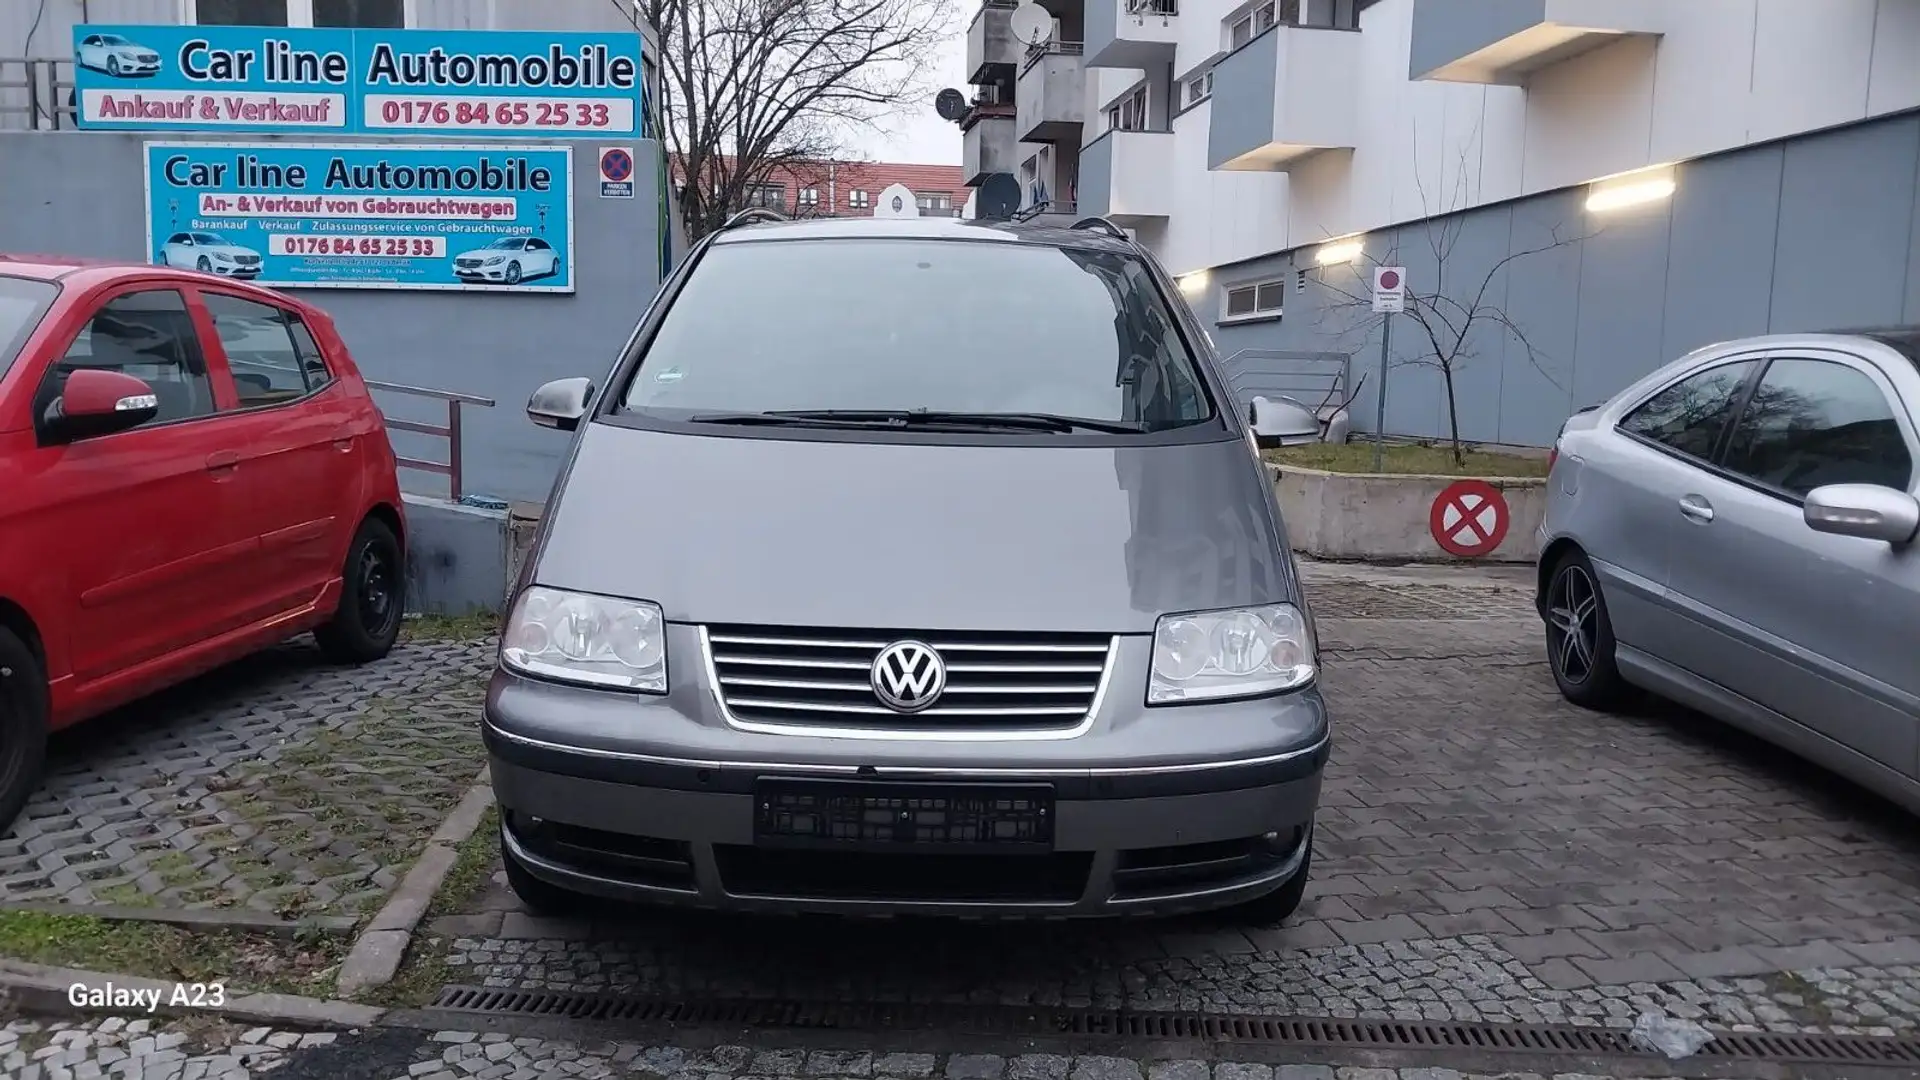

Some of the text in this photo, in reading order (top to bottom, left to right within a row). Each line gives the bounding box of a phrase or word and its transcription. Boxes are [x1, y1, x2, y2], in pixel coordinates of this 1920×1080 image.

[180, 39, 635, 88] Car line Automobile
[99, 94, 331, 122] Ankauf & Verkauf
[382, 100, 610, 127] 0176 84 65 25 33
[165, 154, 552, 192] Car line Automobile
[202, 196, 233, 212] An-
[237, 196, 250, 212] &
[254, 196, 323, 213] Verkauf
[326, 200, 358, 213] von
[362, 197, 515, 219] Gebrauchtwagen
[191, 219, 533, 235] Barankauf Verkauf Zulassungsservice von Gebrauchtwagen
[284, 237, 434, 256] 0176 84 65 25 33
[873, 643, 944, 708] VW
